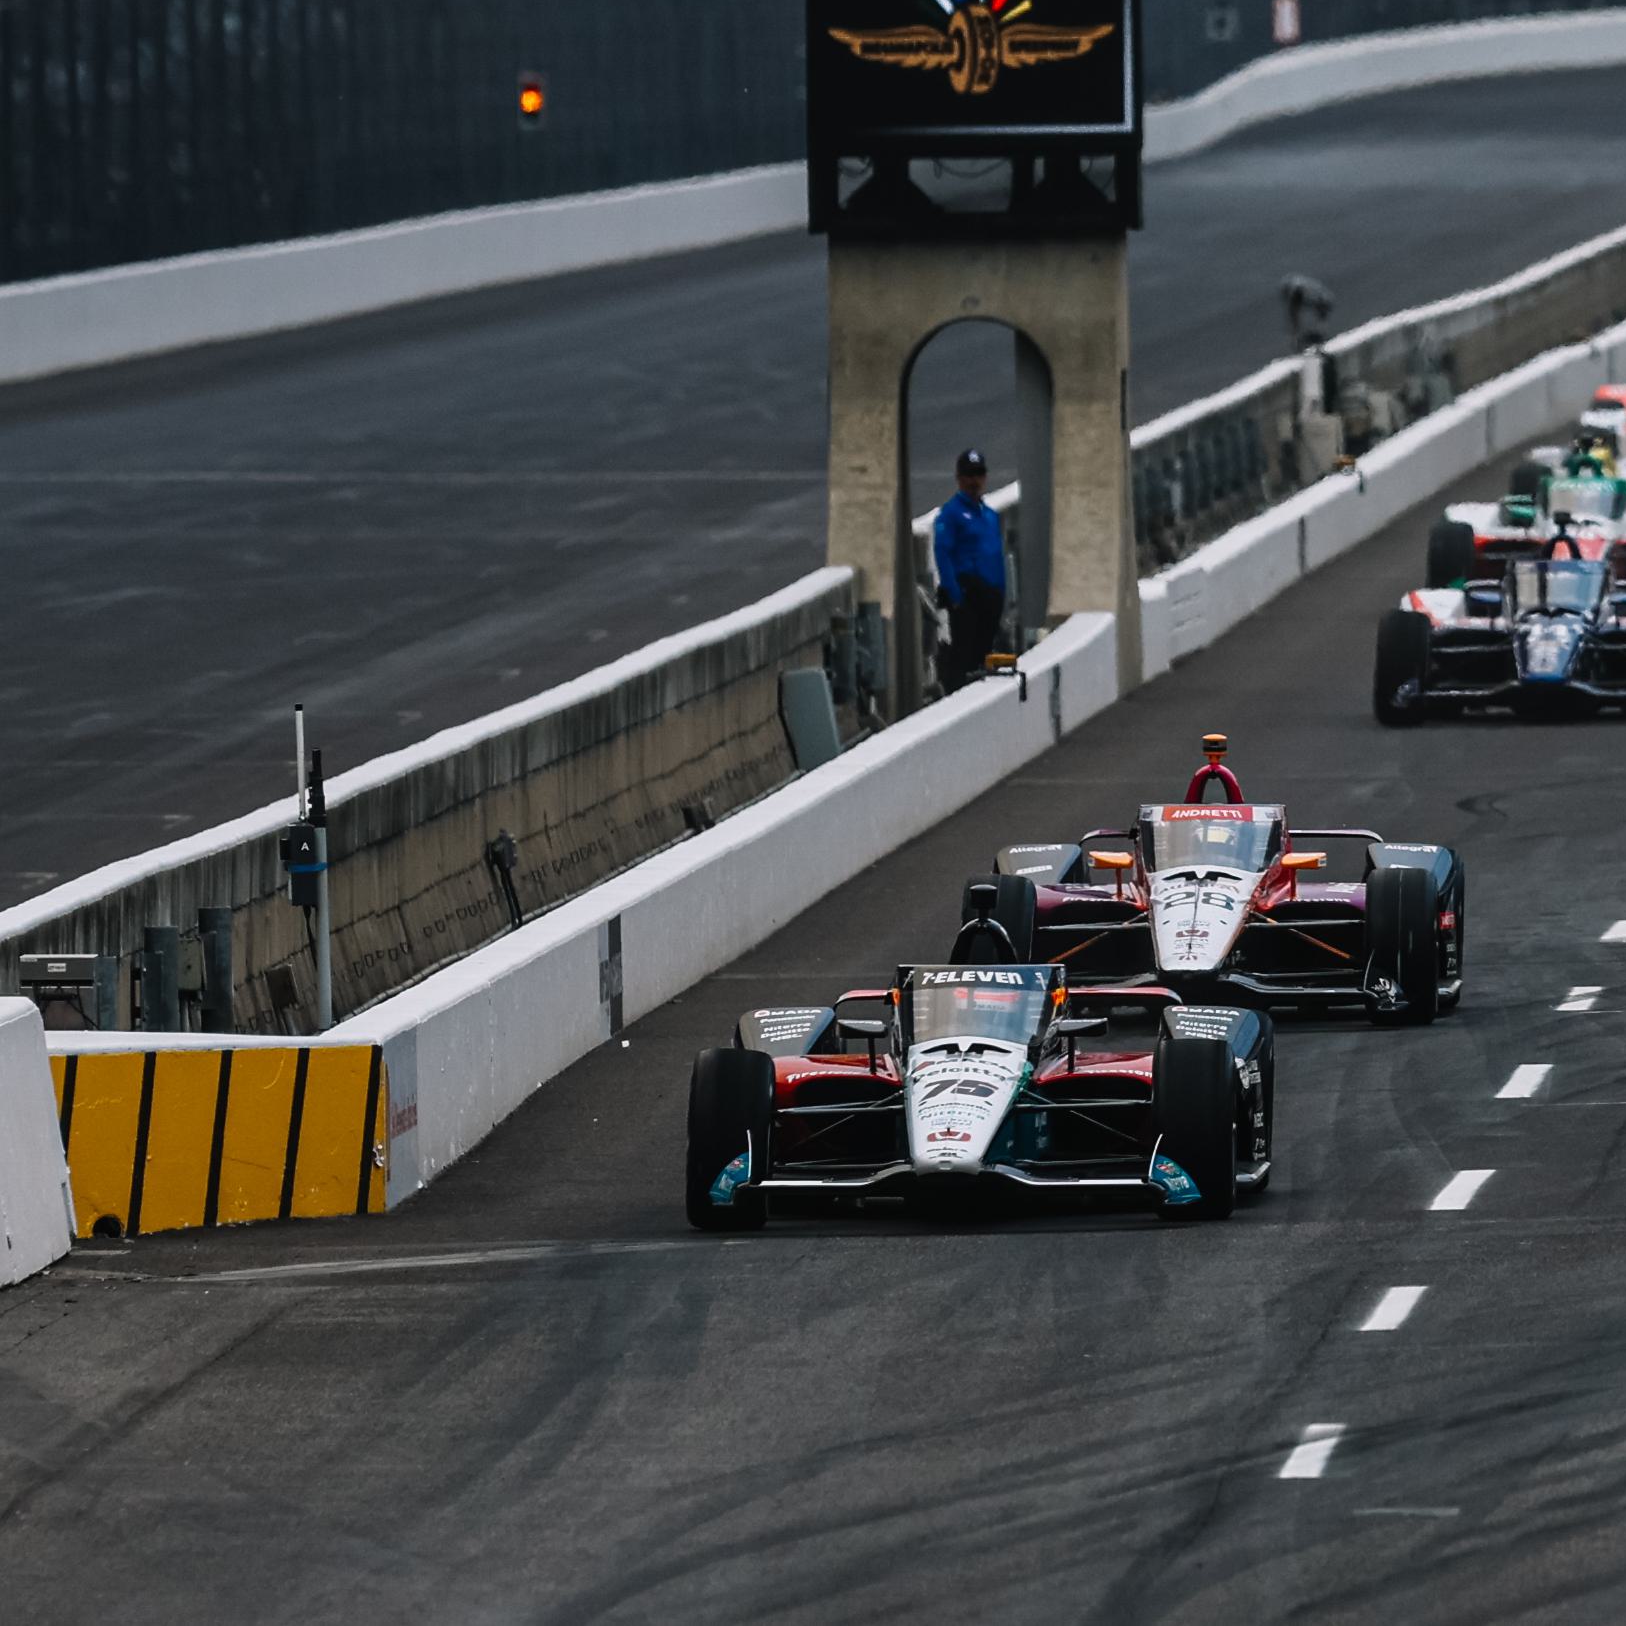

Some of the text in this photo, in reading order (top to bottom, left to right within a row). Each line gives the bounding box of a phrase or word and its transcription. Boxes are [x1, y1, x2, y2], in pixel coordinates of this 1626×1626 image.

[1171, 809, 1243, 819] ANDRETTI
[1163, 891, 1236, 911] 28
[921, 970, 1024, 986] 7-ELEVEN
[918, 1079, 1000, 1103] 75
